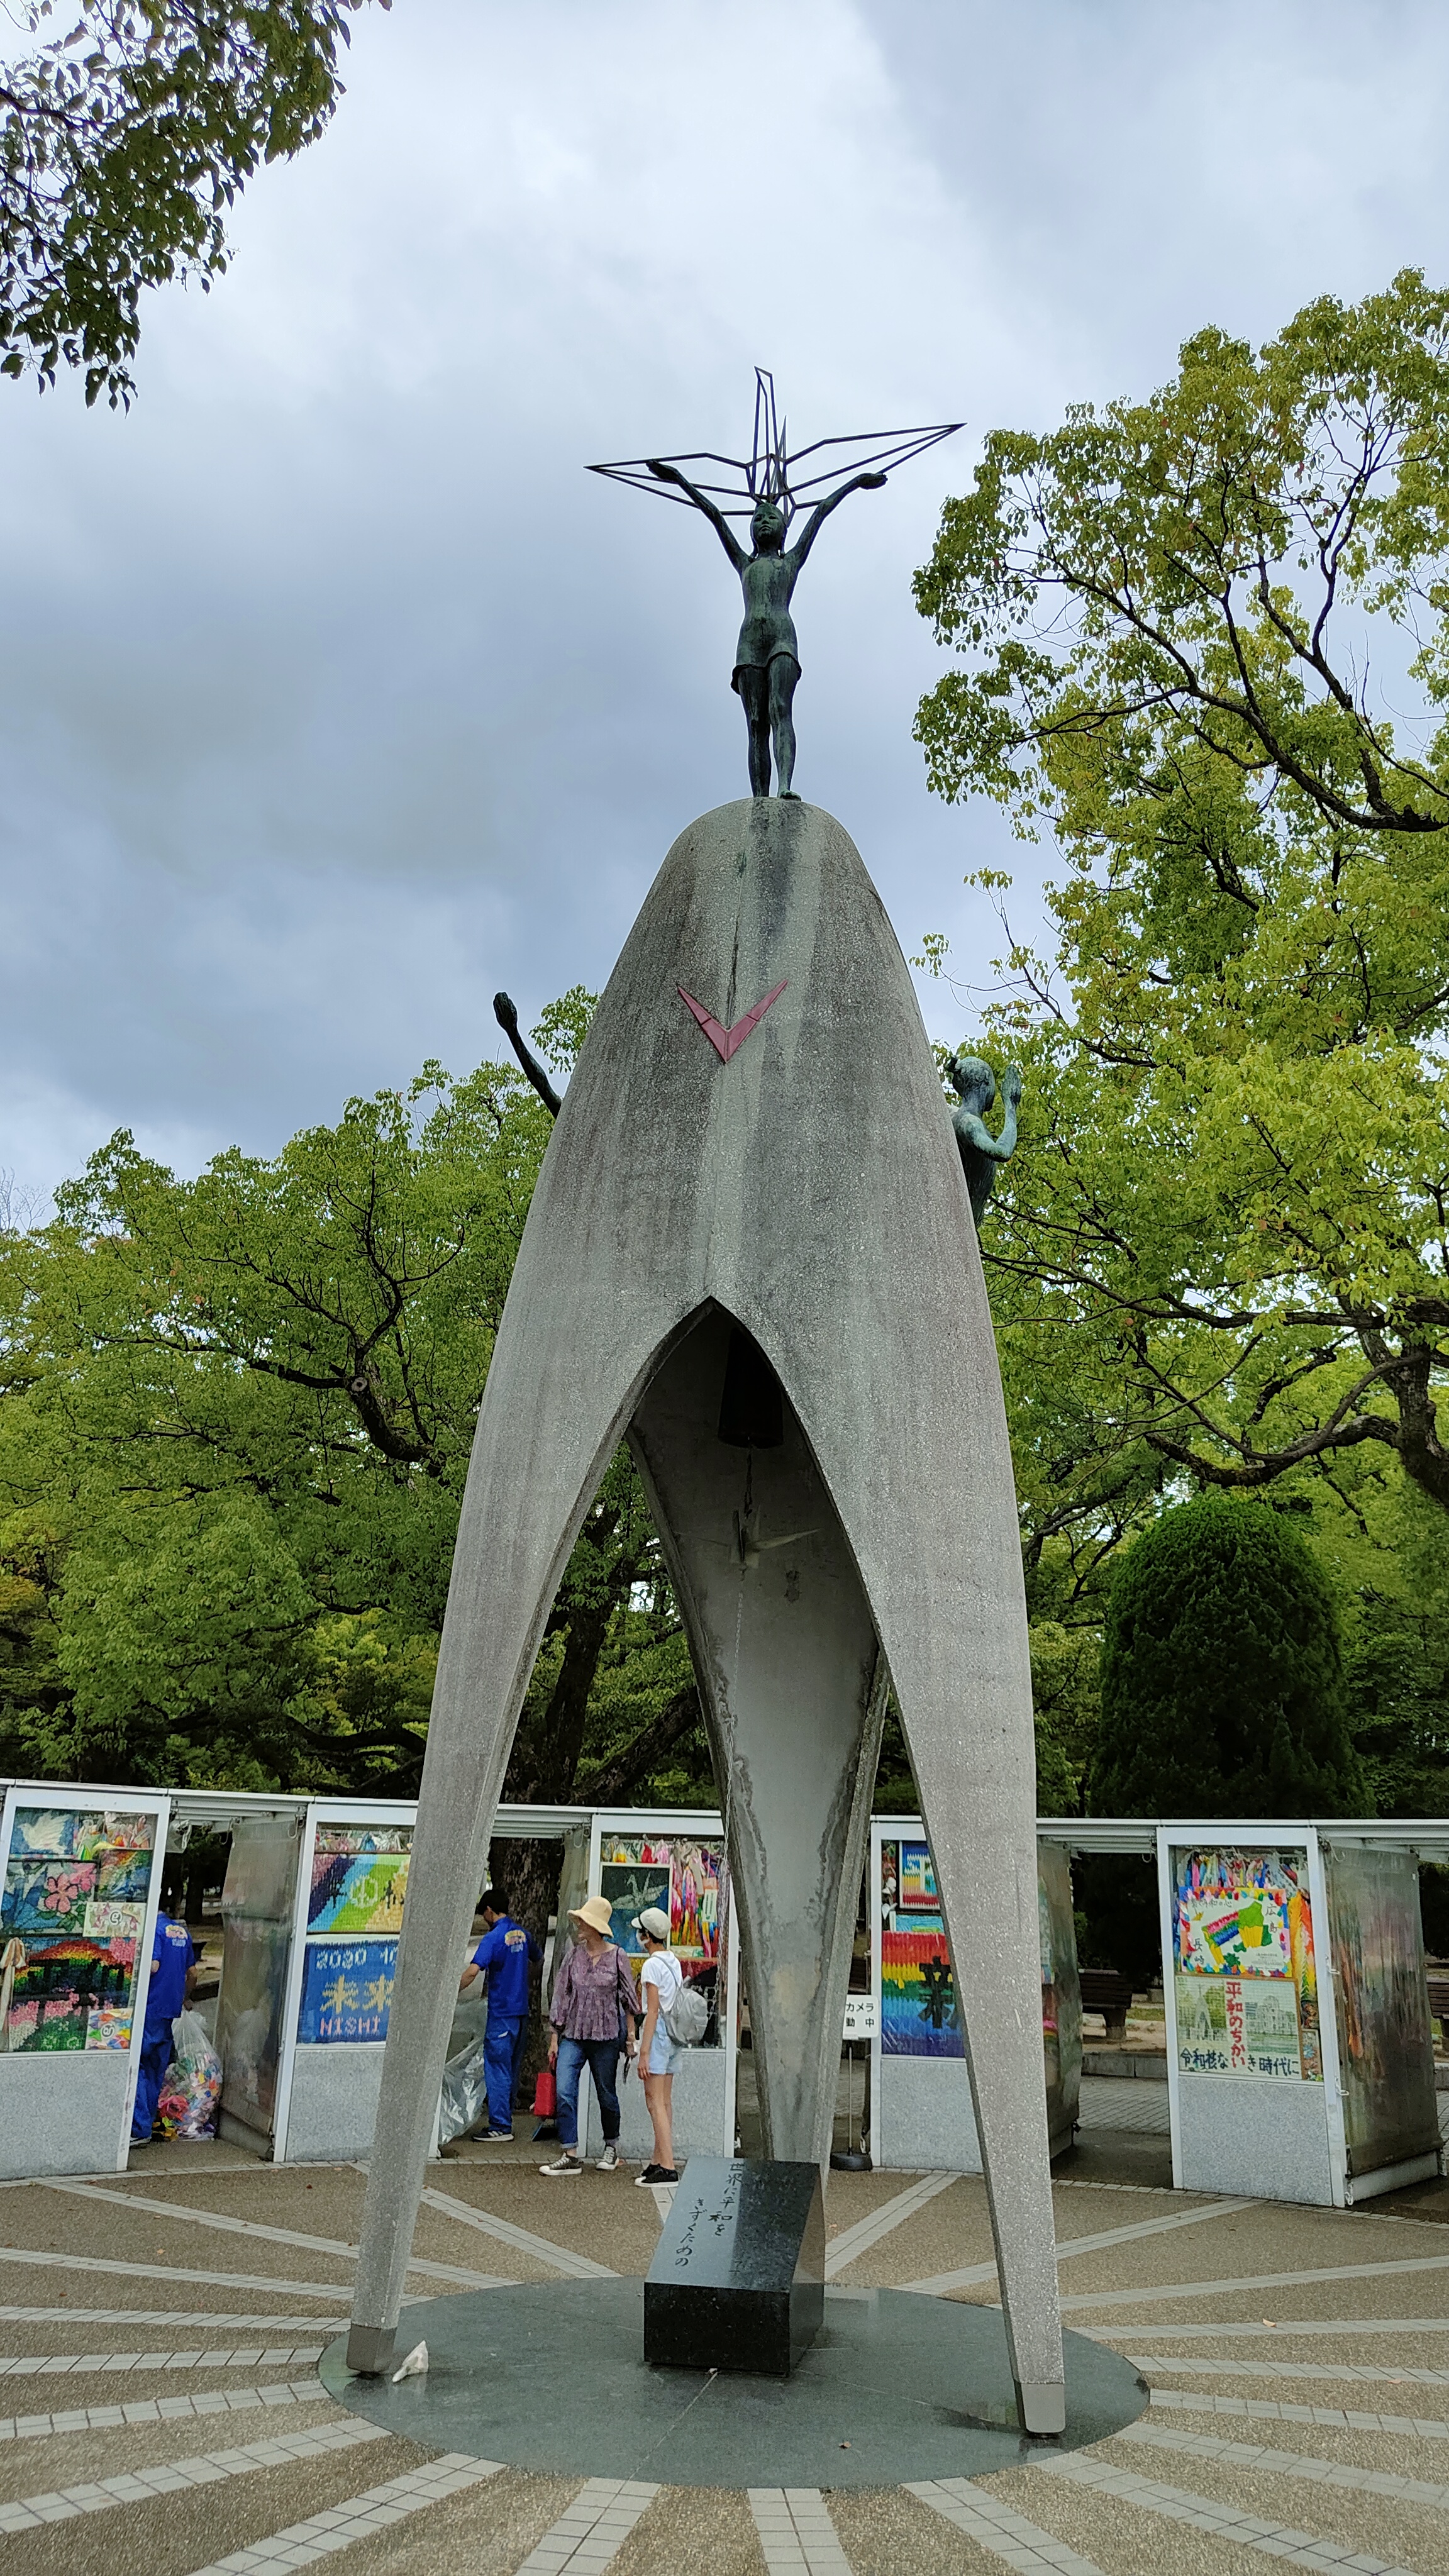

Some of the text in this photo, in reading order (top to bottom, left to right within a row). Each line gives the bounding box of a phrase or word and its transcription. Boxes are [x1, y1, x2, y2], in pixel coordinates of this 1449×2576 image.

[1265, 1904, 1279, 1933] 広島
[1193, 1938, 1204, 1965] 長崎
[319, 2015, 380, 2037] NISHI
[1226, 1981, 1246, 2068] 平和のちかい
[708, 2162, 745, 2236] 世界に平和を
[675, 2197, 708, 2267] きずくための
